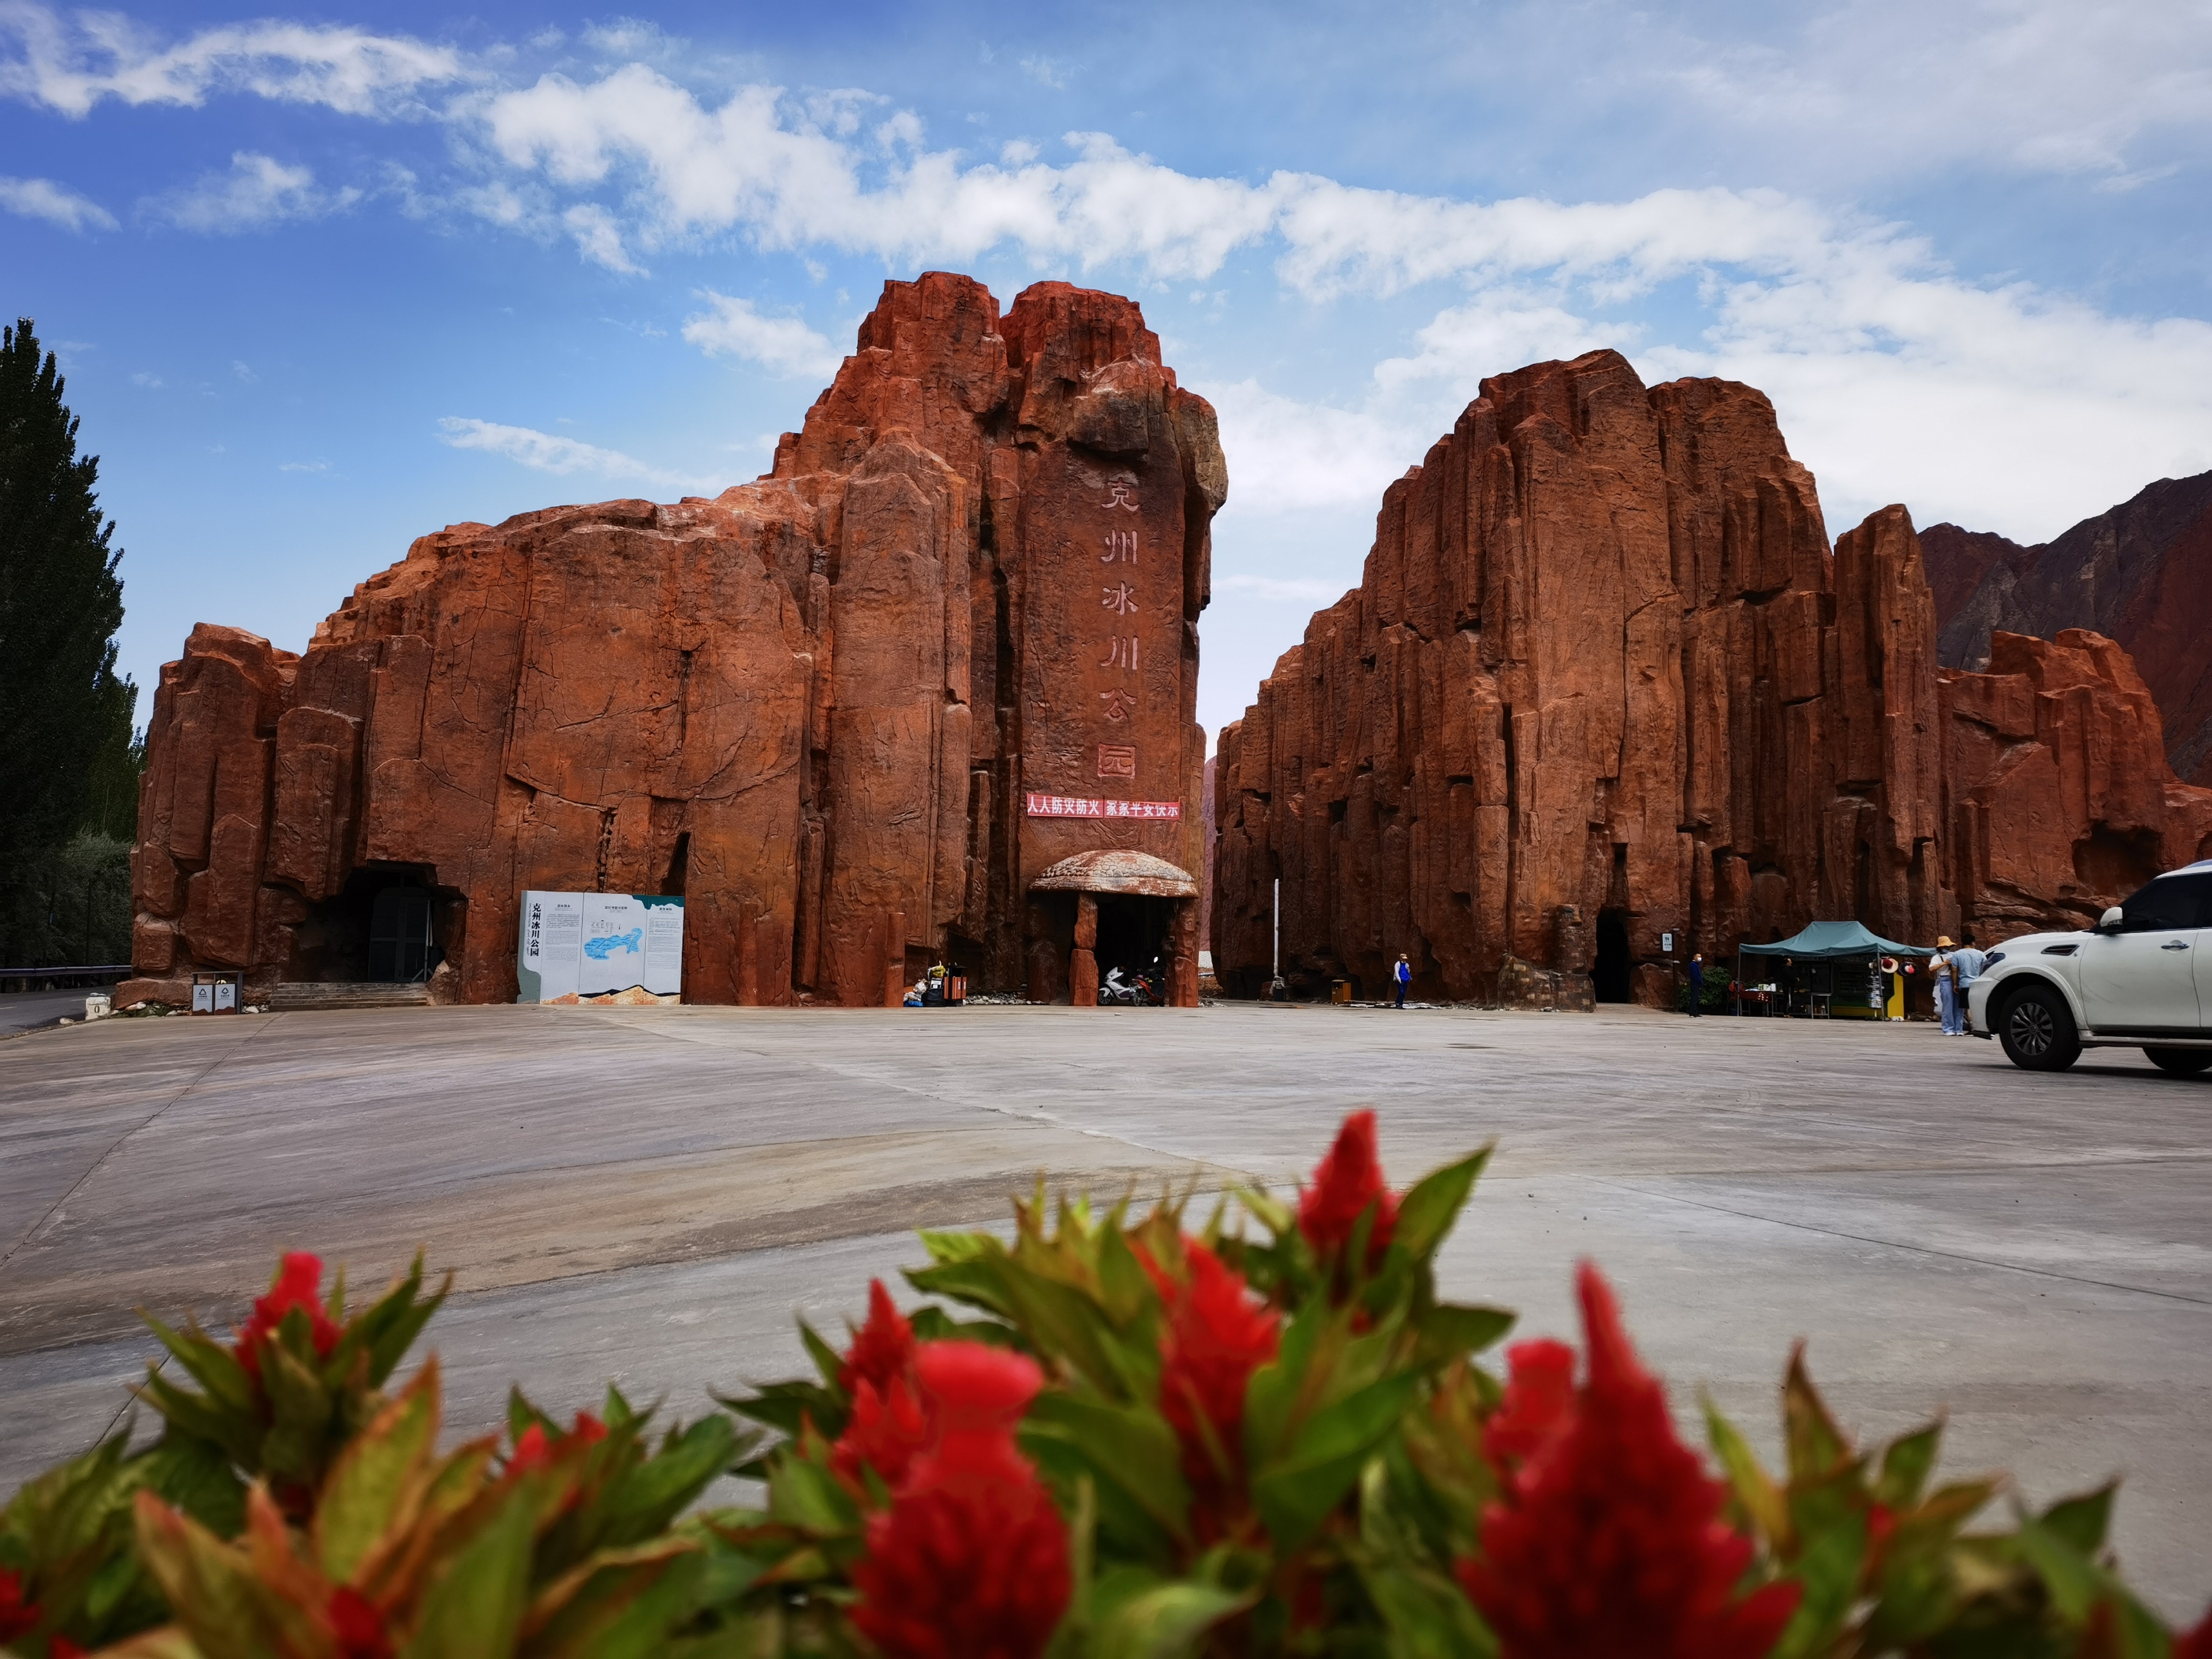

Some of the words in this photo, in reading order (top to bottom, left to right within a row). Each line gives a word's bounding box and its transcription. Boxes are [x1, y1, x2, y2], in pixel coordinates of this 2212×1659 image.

[1098, 477, 1139, 779] 克州冰川公园
[1028, 796, 1099, 815] 人人防灾防火
[530, 902, 541, 957] 克州冰川公园
